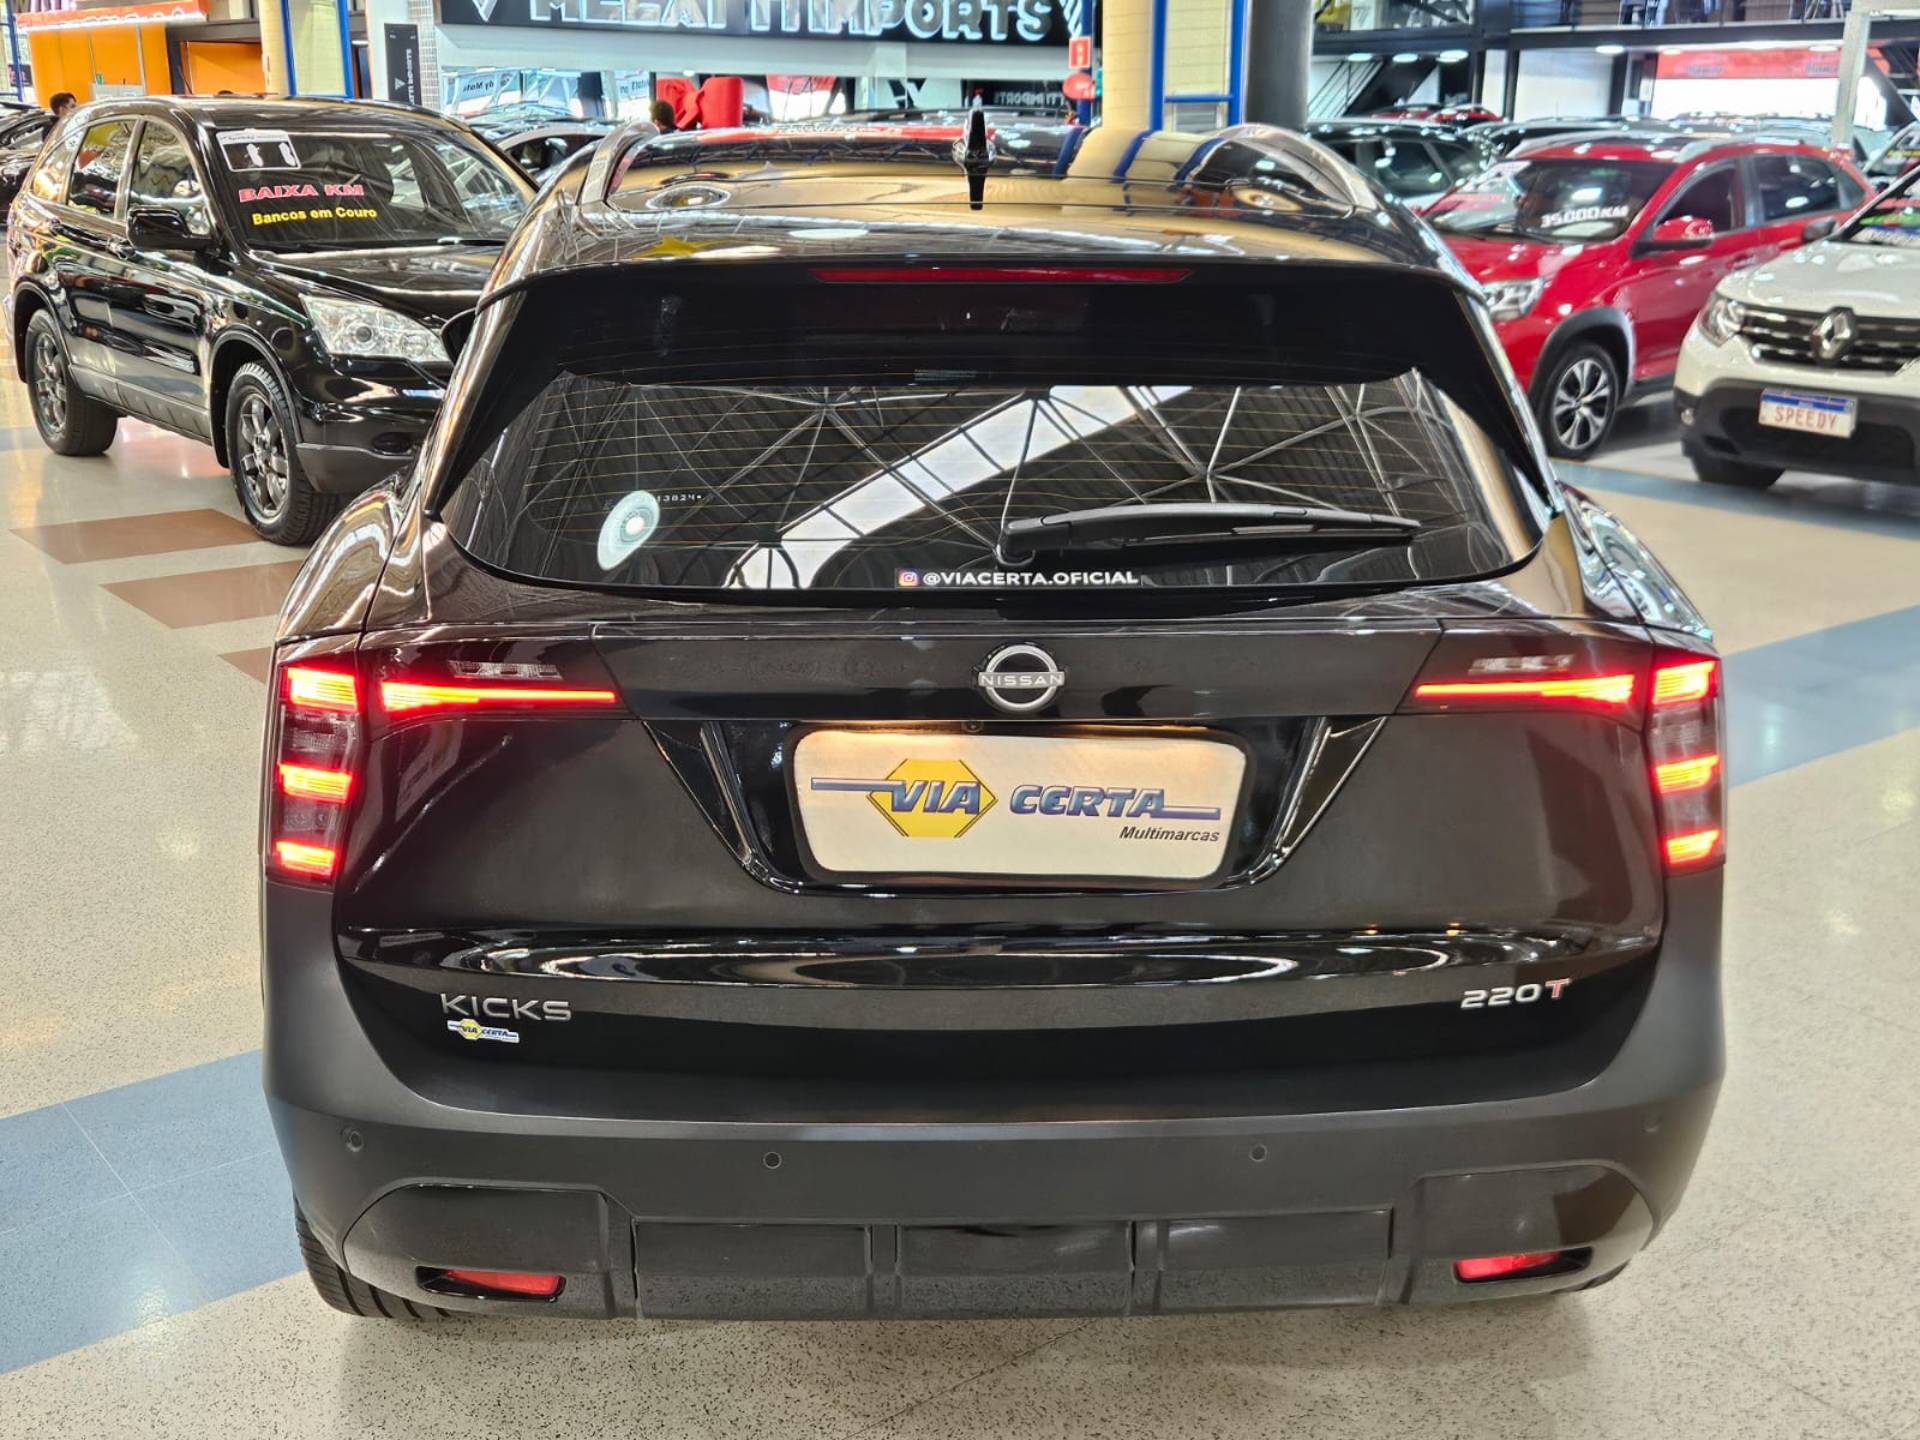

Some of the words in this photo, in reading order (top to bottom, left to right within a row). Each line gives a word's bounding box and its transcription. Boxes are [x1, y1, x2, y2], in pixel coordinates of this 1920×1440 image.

[238, 184, 319, 203] BAIXA
[323, 183, 365, 197] KM
[251, 209, 307, 226] Bancos
[310, 208, 332, 219] em
[335, 206, 378, 219] Couro
[1775, 405, 1838, 430] SPEEDY
[922, 571, 1139, 586] @VIACERTA.OFICIAL
[981, 674, 1063, 687] NISSAN
[889, 779, 981, 815] VIA
[1009, 784, 1166, 819] CERTA
[1119, 824, 1220, 844] Multimarcas
[1460, 978, 1573, 1009] 220T
[440, 993, 572, 1021] KICKS
[462, 1025, 478, 1034] VIA
[481, 1027, 509, 1037] CERTA
